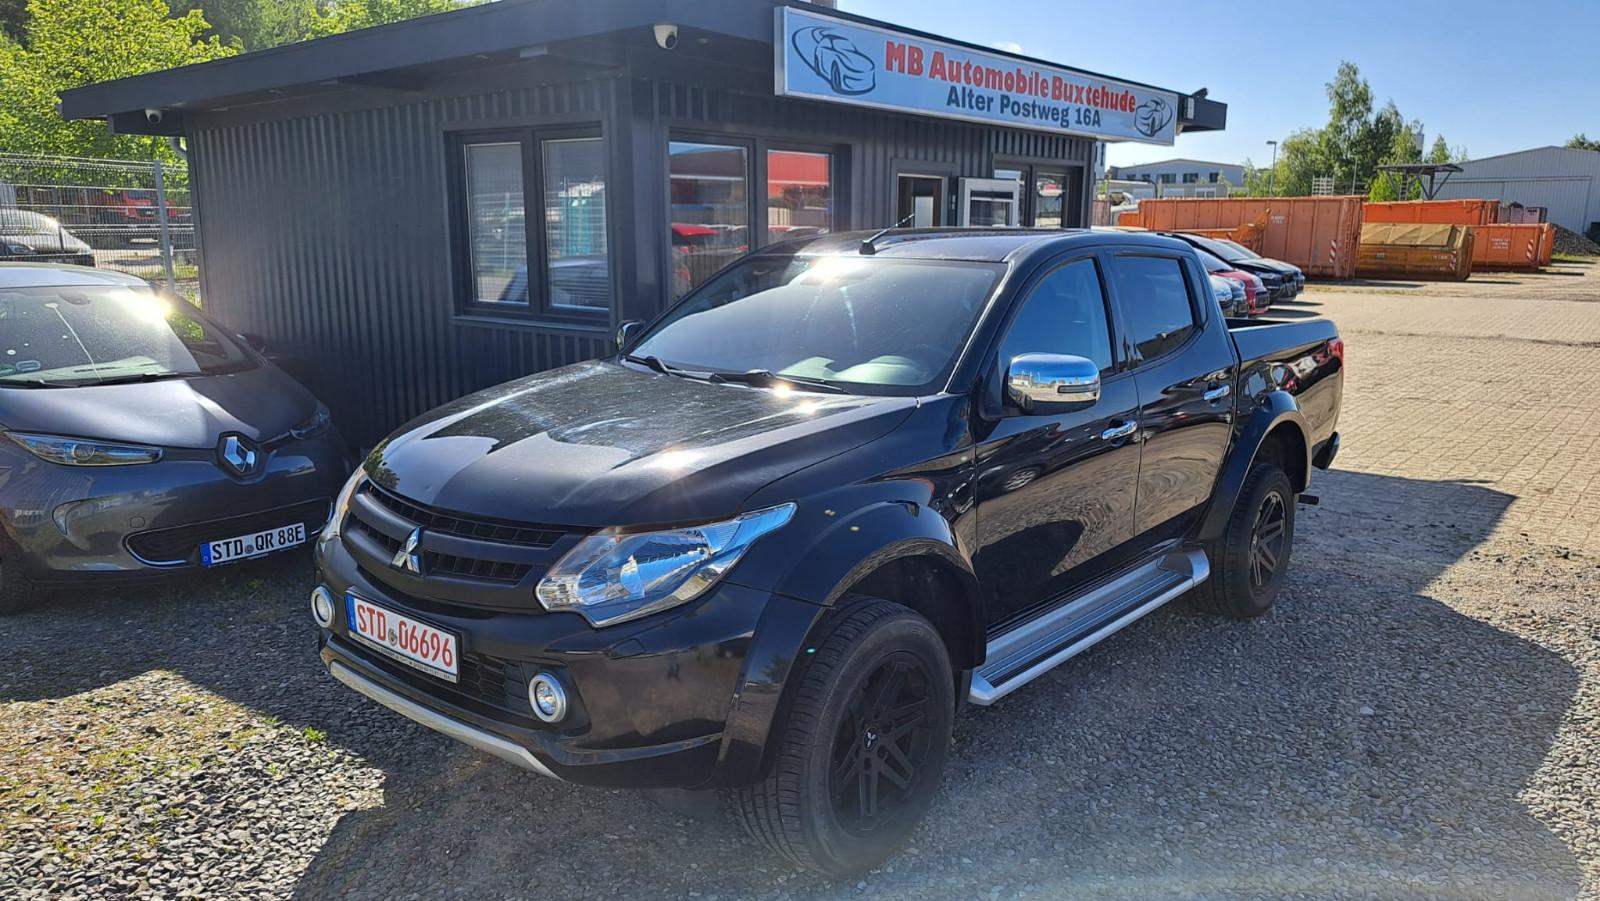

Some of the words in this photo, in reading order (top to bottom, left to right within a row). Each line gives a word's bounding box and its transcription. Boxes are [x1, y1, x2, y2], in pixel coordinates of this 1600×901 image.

[885, 40, 923, 76] MB
[929, 51, 1049, 98] Automobile
[1052, 76, 1135, 112] Buxtehude
[947, 86, 994, 112] Alter
[1000, 94, 1069, 128] Postweg
[1075, 107, 1101, 127] 16A
[212, 540, 243, 560] STD
[255, 532, 274, 550] QR
[278, 525, 304, 545] 88E
[357, 604, 387, 641] STD
[398, 620, 453, 668] 06696
